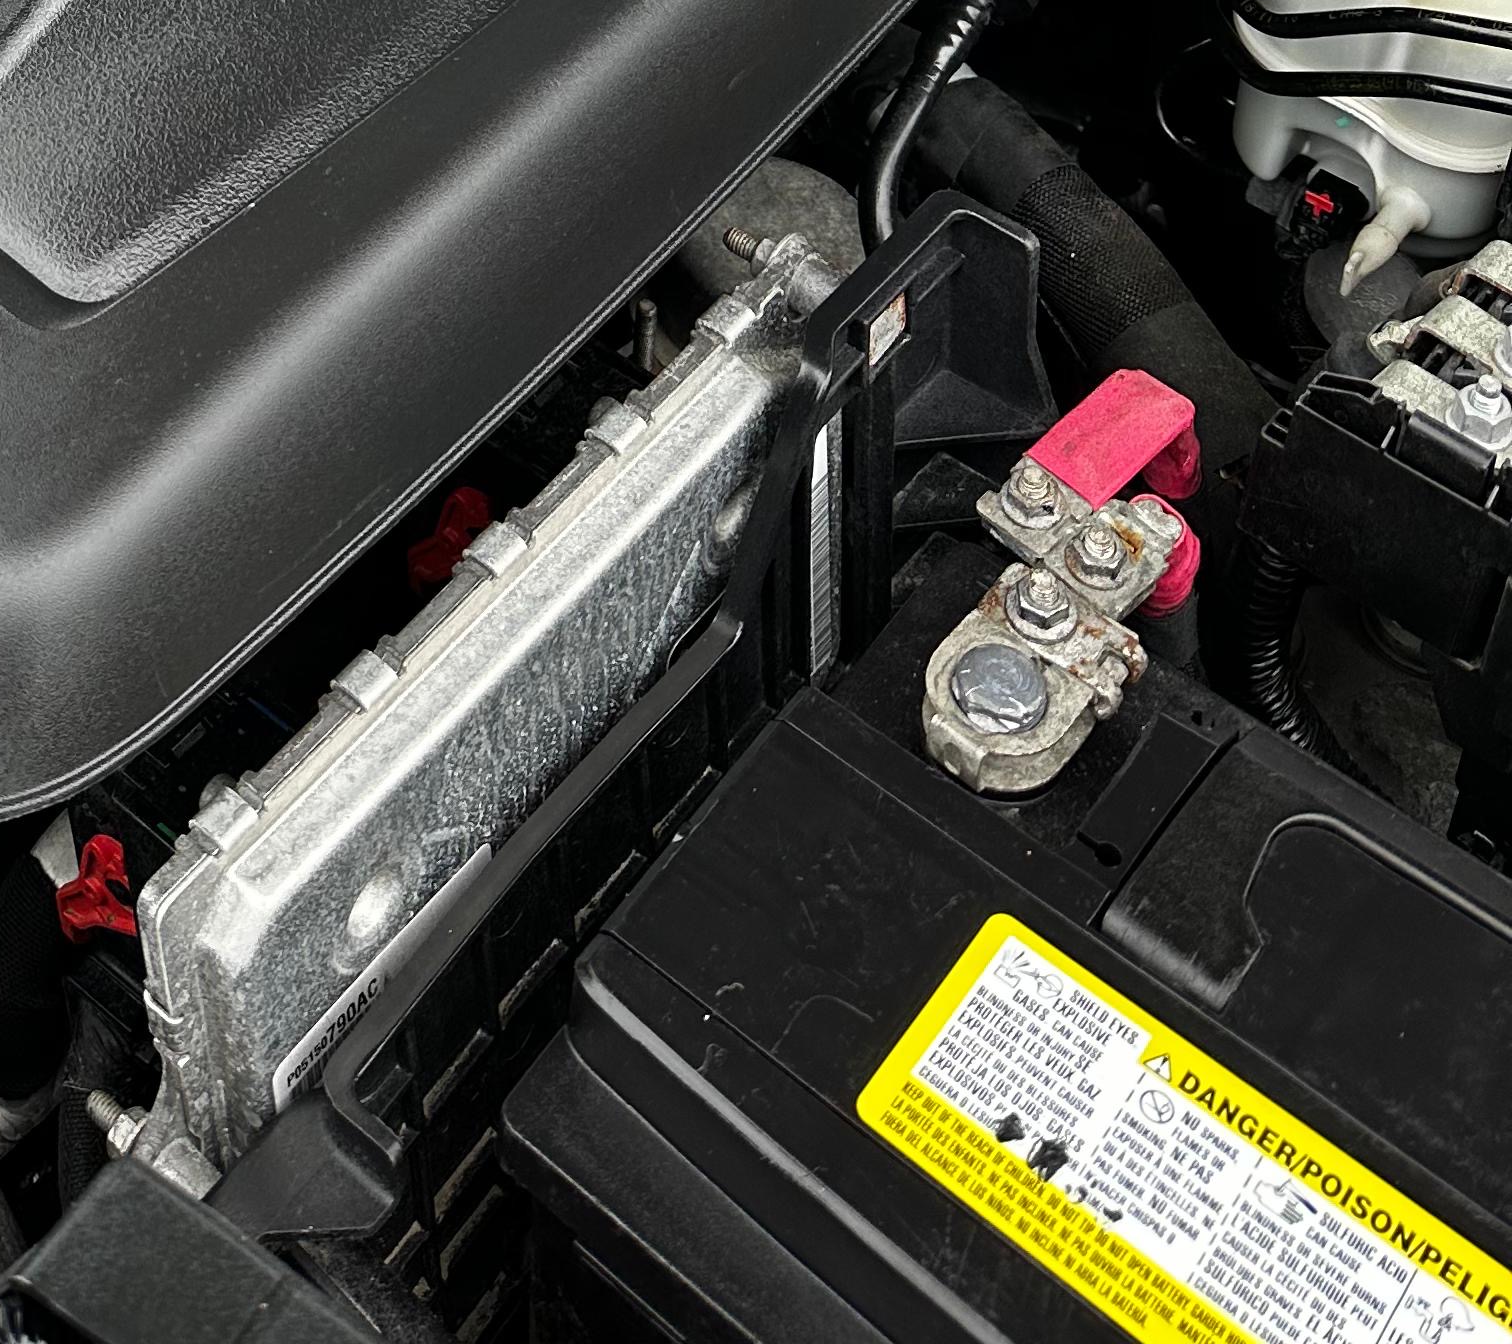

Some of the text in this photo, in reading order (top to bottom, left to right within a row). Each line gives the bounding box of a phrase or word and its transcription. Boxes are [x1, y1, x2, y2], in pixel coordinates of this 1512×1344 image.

[287, 978, 378, 1088] P05150790AC
[975, 984, 1093, 1074] BLINDNESS OR INJURY SE
[1051, 996, 1112, 1047] EXPLOSIVE
[1051, 1019, 1074, 1040] CAN
[1071, 1034, 1103, 1062] CAUSE
[1068, 988, 1110, 1024] SHIELD
[917, 1064, 960, 1101] CEGUERA
[926, 1049, 996, 1106] EXPLOSIVOS
[946, 1024, 962, 1040] LA
[1004, 1068, 1026, 1089] DES
[1024, 1082, 1079, 1128] BLESSURES
[986, 1073, 1012, 1098] LOS
[1014, 1054, 1057, 1090] PEUVENT
[1055, 1085, 1095, 1119] CAUSER
[1020, 1036, 1046, 1060] LES
[1075, 1077, 1102, 1101] GAZ
[1170, 1126, 1211, 1160] FLAMES
[1180, 1110, 1201, 1131] NO
[889, 1094, 905, 1111] LA
[930, 1126, 951, 1147] DES
[986, 1169, 1002, 1186] NE
[998, 1179, 1020, 1200] PAS
[1056, 1225, 1073, 1242] NE
[1069, 1235, 1091, 1256] PAS
[1119, 1273, 1137, 1292] LA
[1091, 1155, 1113, 1175] PAS
[1146, 1193, 1168, 1215] NO
[1164, 1209, 1201, 1241] FUMAR
[1110, 1125, 1155, 1162] EXPOSER
[1161, 1163, 1183, 1184] UNE
[1181, 1178, 1225, 1215] FLAMME
[1124, 1157, 1145, 1177] DES
[1200, 1214, 1216, 1231] NE
[1169, 1145, 1190, 1166] NE
[1187, 1159, 1215, 1185] PAS
[879, 1109, 909, 1136] FUERA
[903, 1129, 923, 1148] DEL
[918, 1141, 960, 1177] ALCANCE
[956, 1170, 971, 1186] DE
[967, 1178, 989, 1200] LOS
[1014, 1215, 1032, 1234] NO
[1097, 1280, 1114, 1298] LA
[900, 1080, 924, 1103] KEEP
[920, 1095, 941, 1115] OUT
[937, 1108, 952, 1125] OF
[949, 1117, 968, 1137] THE
[964, 1129, 995, 1158] REACH
[991, 1151, 1005, 1166] OF
[1045, 1192, 1062, 1210] DO
[1058, 1202, 1080, 1224] NOT
[1106, 1239, 1129, 1261] NOT
[1125, 1254, 1154, 1281] OPEN
[1188, 1303, 1228, 1338] GARDER
[1220, 1230, 1261, 1265] CAUSER
[1259, 1259, 1276, 1276] LA
[1324, 1308, 1348, 1330] DES
[1238, 1199, 1297, 1247] BLINDNESS
[1310, 1253, 1350, 1287] SEVERE
[1348, 1281, 1388, 1315] BURNS
[1304, 1225, 1363, 1274] CAN CAUSE
[1317, 1211, 1409, 1284] SULFURIC ACID
[1275, 1247, 1352, 1310] SULFURIQUE
[1348, 1303, 1378, 1330] PEUT
[1304, 1313, 1325, 1334] EL
